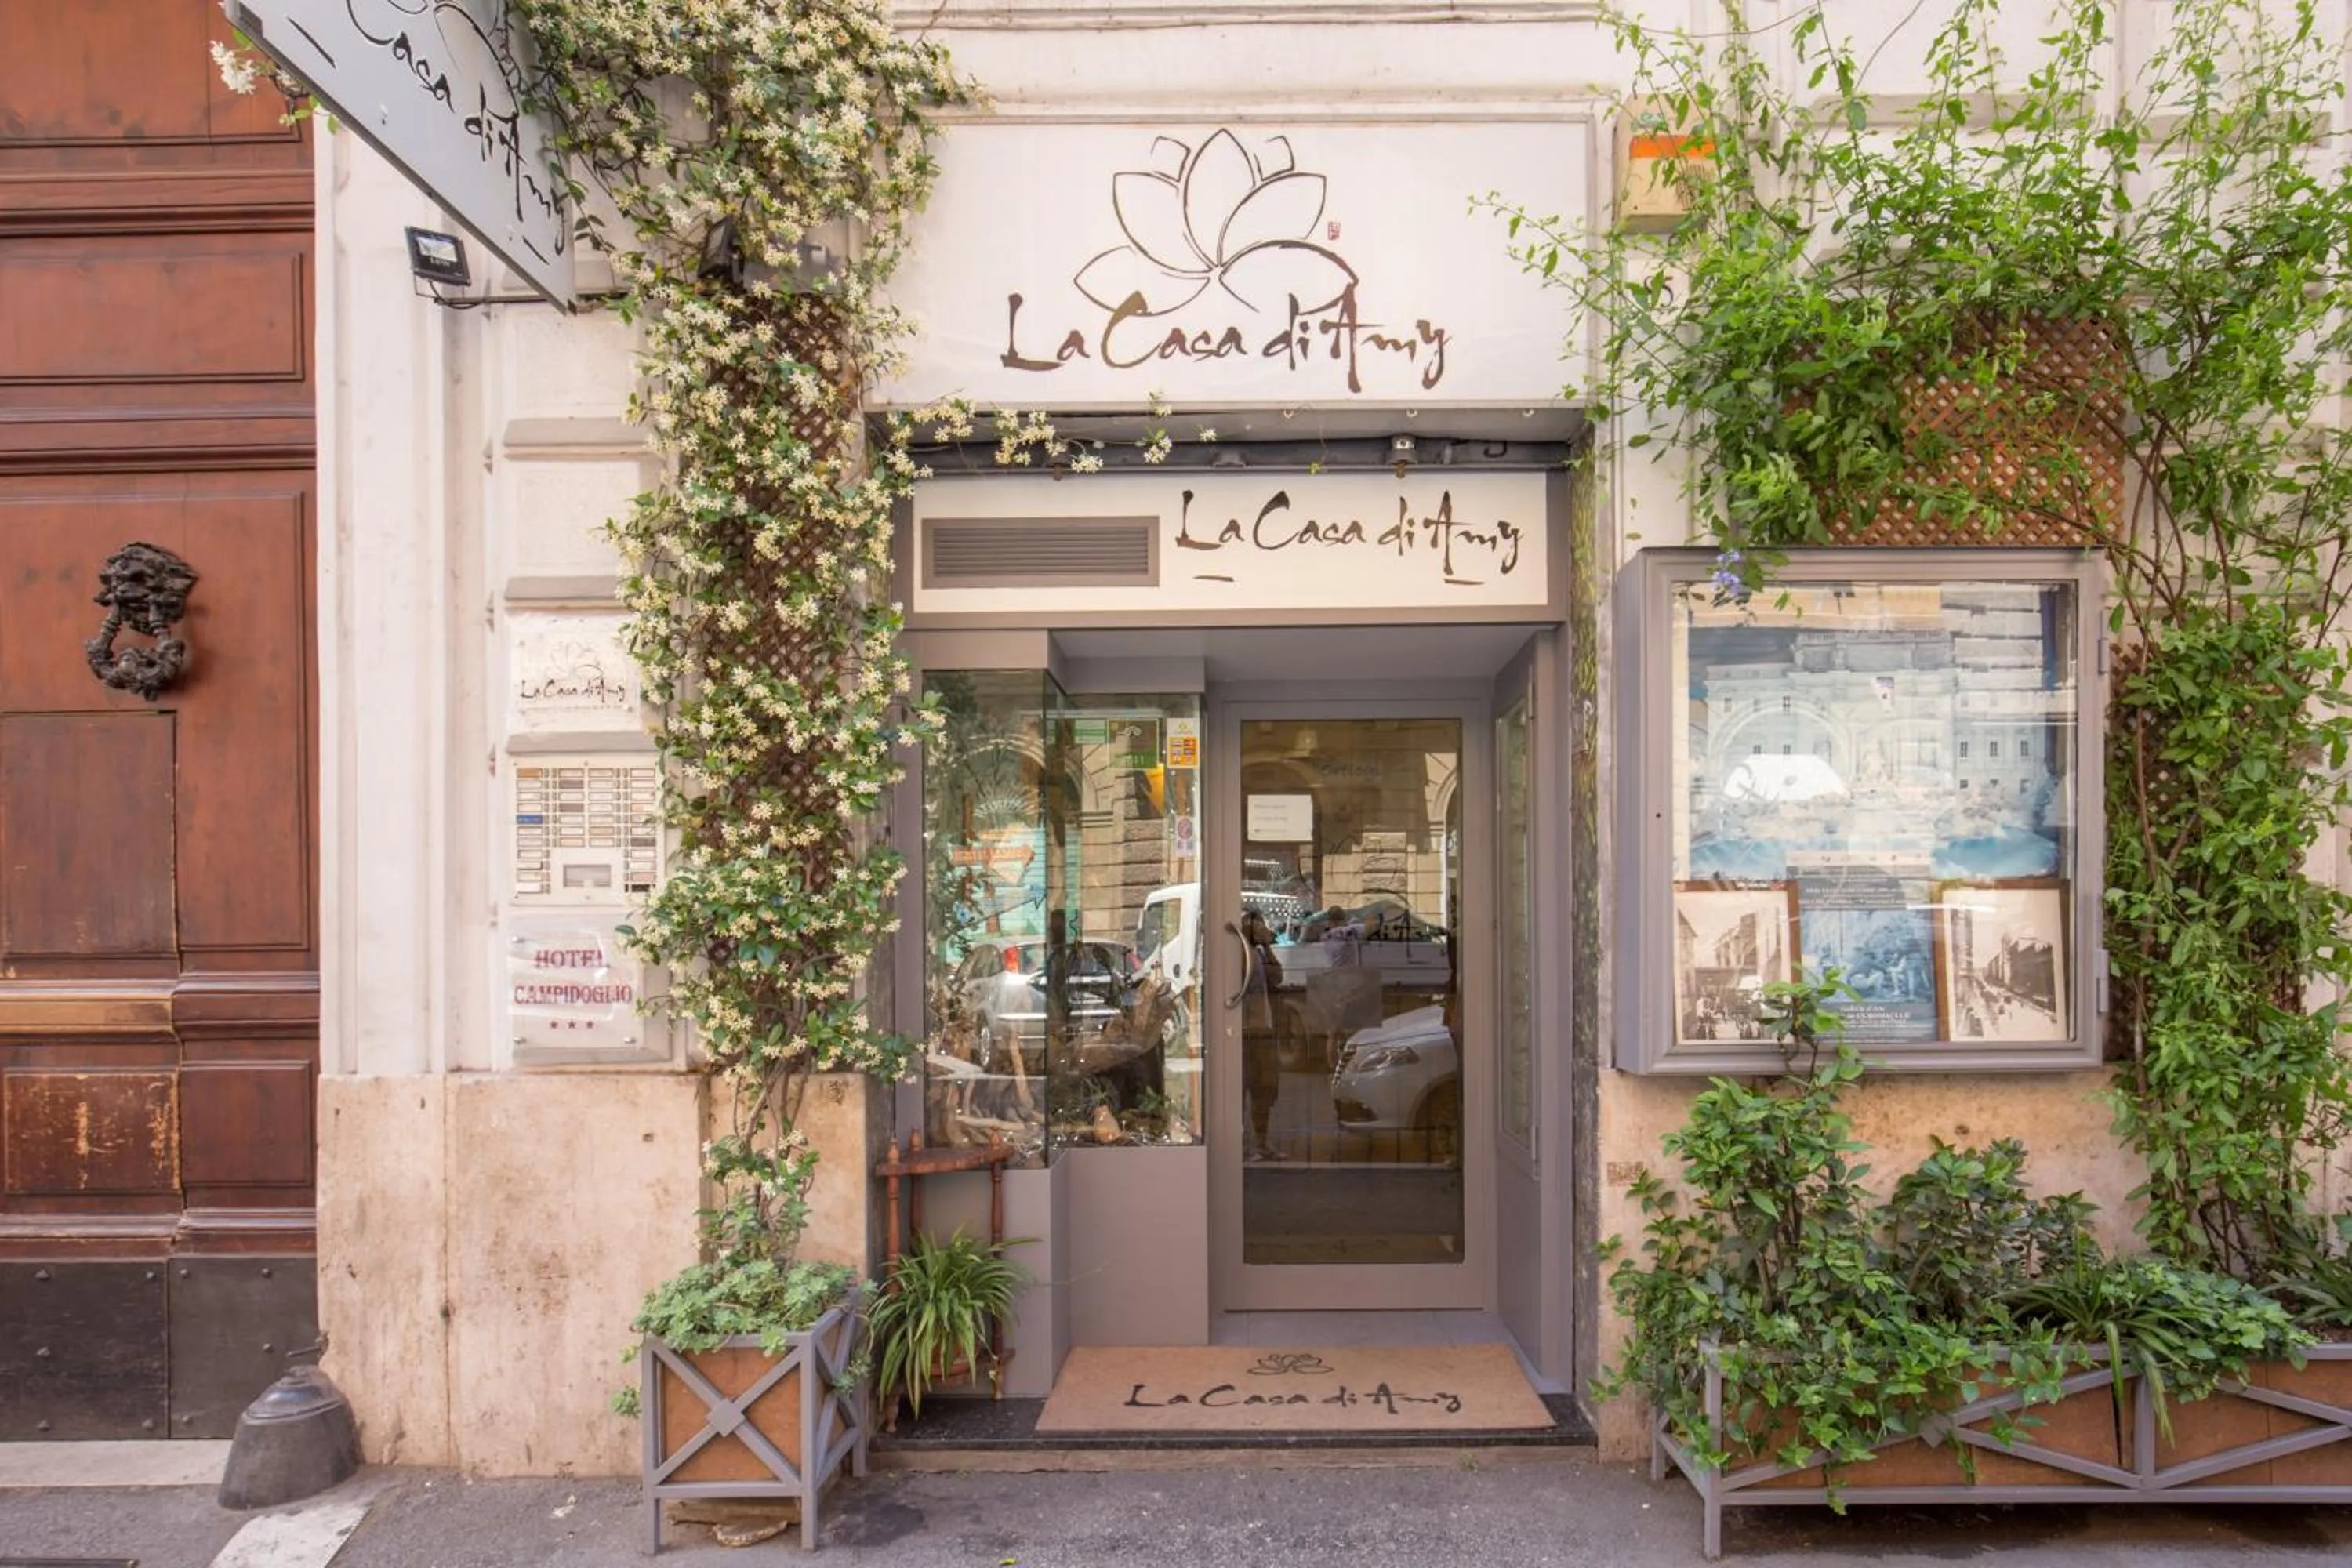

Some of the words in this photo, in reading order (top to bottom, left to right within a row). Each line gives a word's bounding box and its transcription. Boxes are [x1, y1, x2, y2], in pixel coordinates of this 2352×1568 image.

[347, 0, 454, 113] asa
[464, 82, 492, 162] di
[499, 111, 569, 256] Amy
[1000, 292, 1089, 371] La
[1100, 290, 1248, 368] Casa
[1261, 292, 1311, 370] di
[1320, 282, 1452, 393] Amy
[1175, 489, 1245, 550] La
[1253, 489, 1367, 550] Casa
[1377, 495, 1416, 556] di
[1423, 489, 1523, 575] Amy
[521, 679, 540, 698] La
[544, 678, 578, 698] Casa
[514, 985, 633, 1004] CAMPIDOGLIO
[1123, 1384, 1192, 1407] La
[1199, 1384, 1310, 1407] Casa
[1322, 1385, 1357, 1408] di
[1363, 1382, 1461, 1414] Amy
